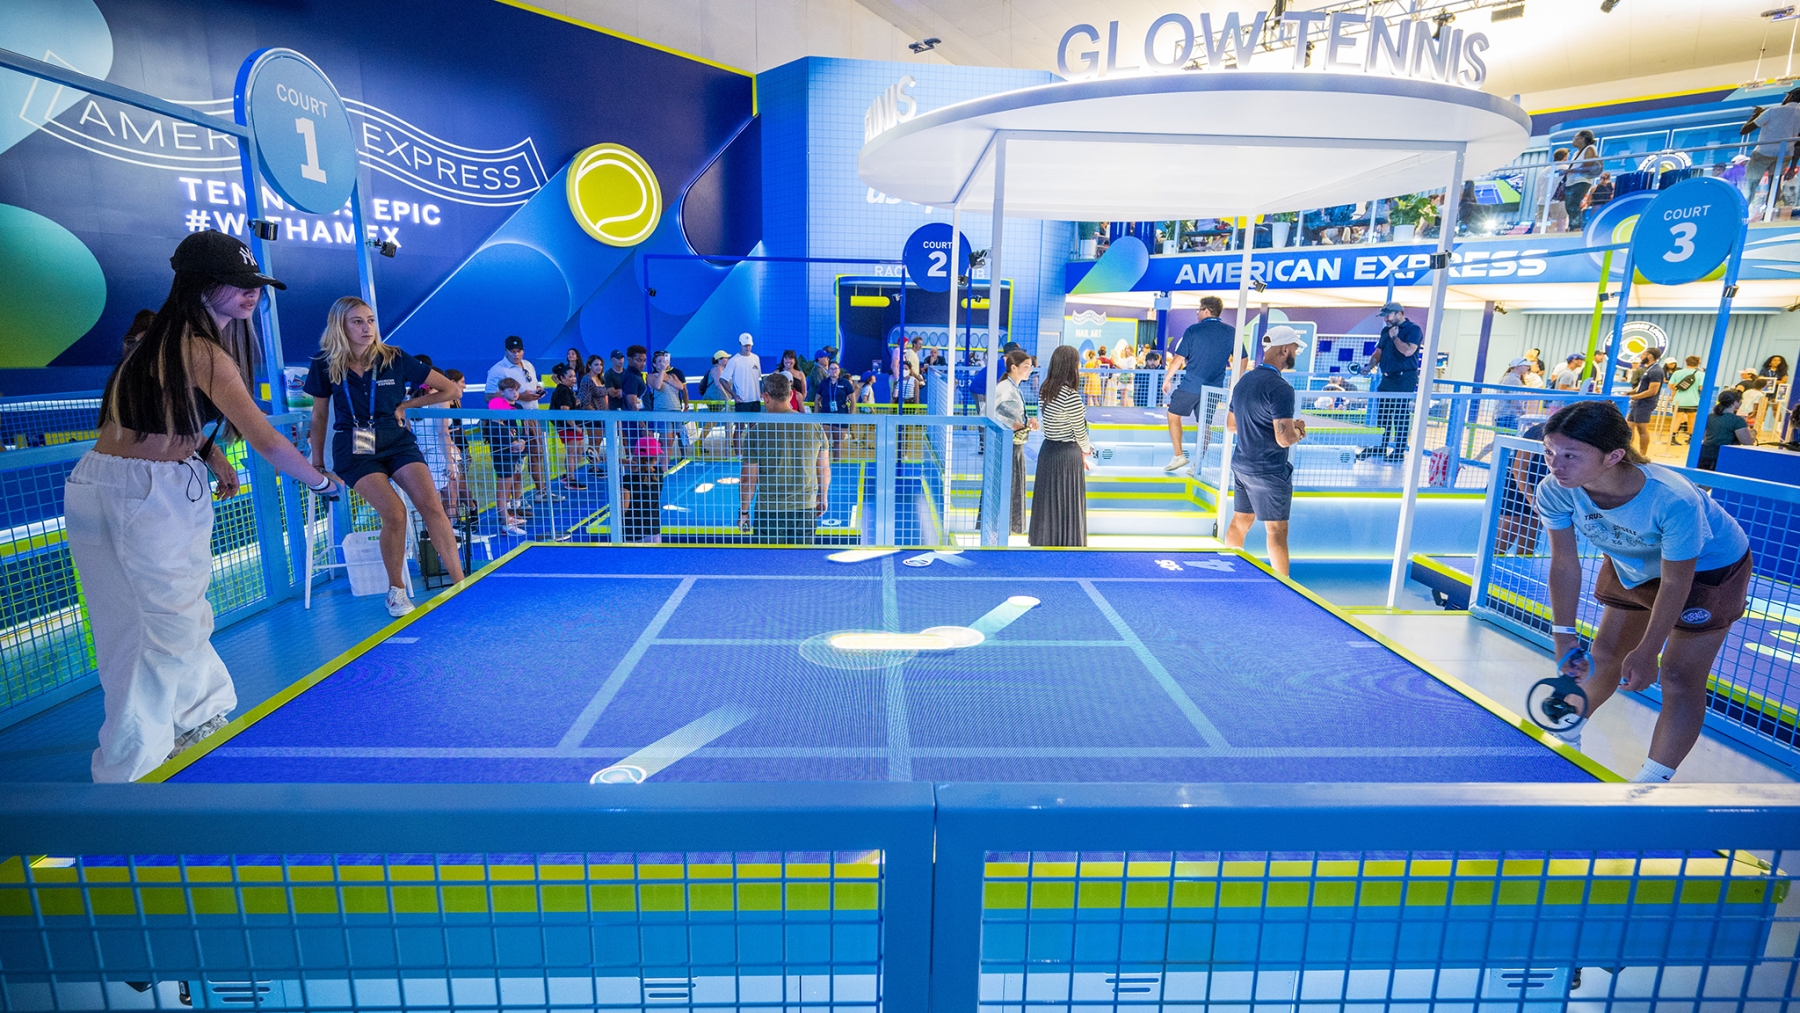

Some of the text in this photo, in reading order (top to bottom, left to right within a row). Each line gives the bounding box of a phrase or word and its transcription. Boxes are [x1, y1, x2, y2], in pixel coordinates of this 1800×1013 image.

[1057, 11, 1490, 90] GLOW TENNIS
[276, 83, 328, 118] COURT
[79, 100, 521, 190] AMER EXPRESS
[295, 117, 327, 184] 1
[374, 198, 441, 225] EPIC
[1663, 204, 1712, 221] COURT
[923, 241, 952, 249] COURT
[1662, 222, 1698, 263] 3
[927, 251, 948, 277] 2
[1175, 257, 1342, 284] AMERICAN
[1075, 329, 1103, 338] NAIL ART
